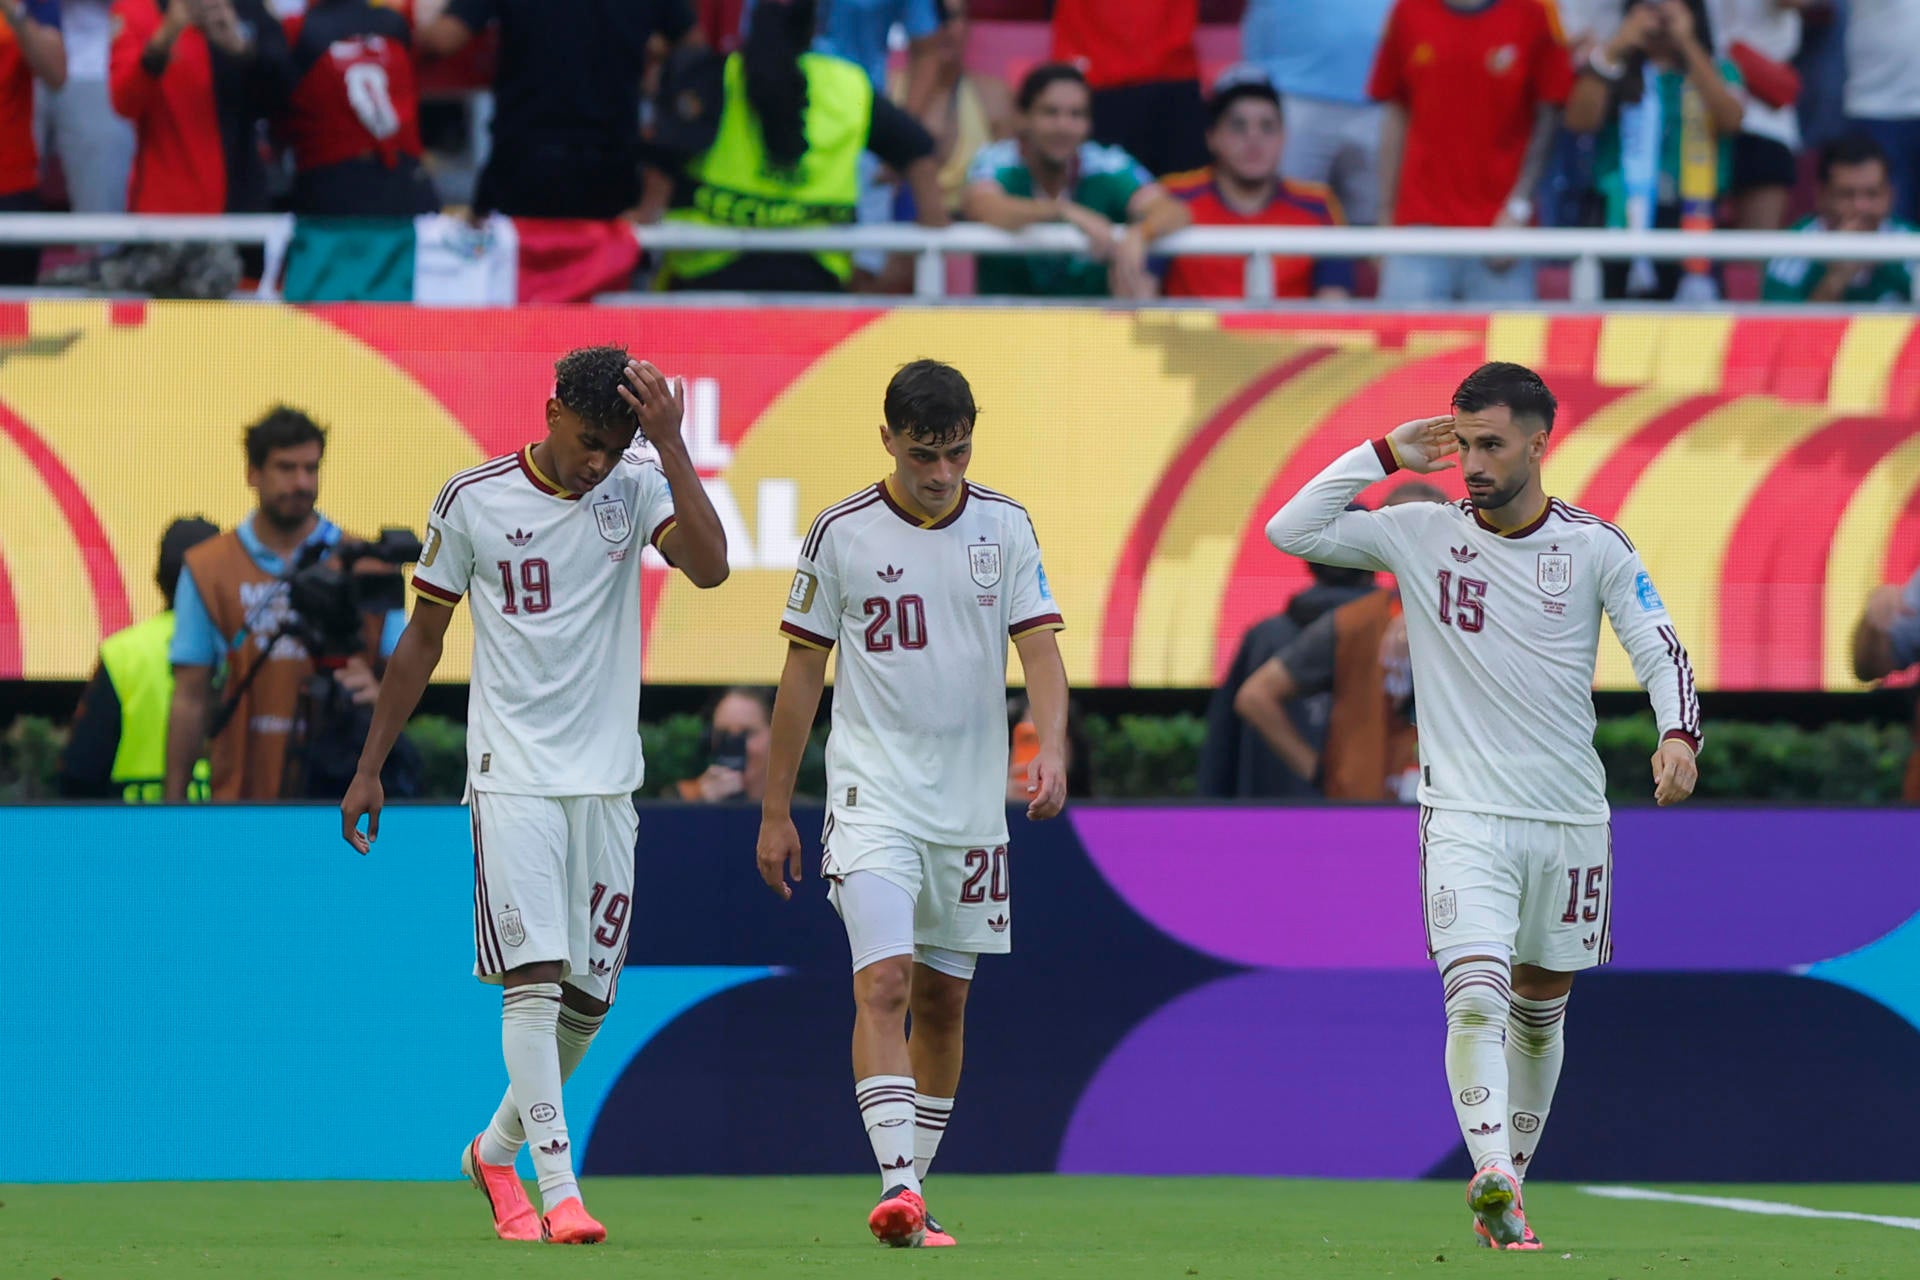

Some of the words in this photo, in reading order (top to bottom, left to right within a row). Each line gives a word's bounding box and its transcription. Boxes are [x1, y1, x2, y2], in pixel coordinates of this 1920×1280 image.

[497, 557, 552, 616] 19
[1437, 569, 1488, 633] 15
[863, 594, 928, 653] 20
[959, 845, 1009, 903] 20
[1560, 864, 1604, 923] 15
[590, 881, 630, 949] 19
